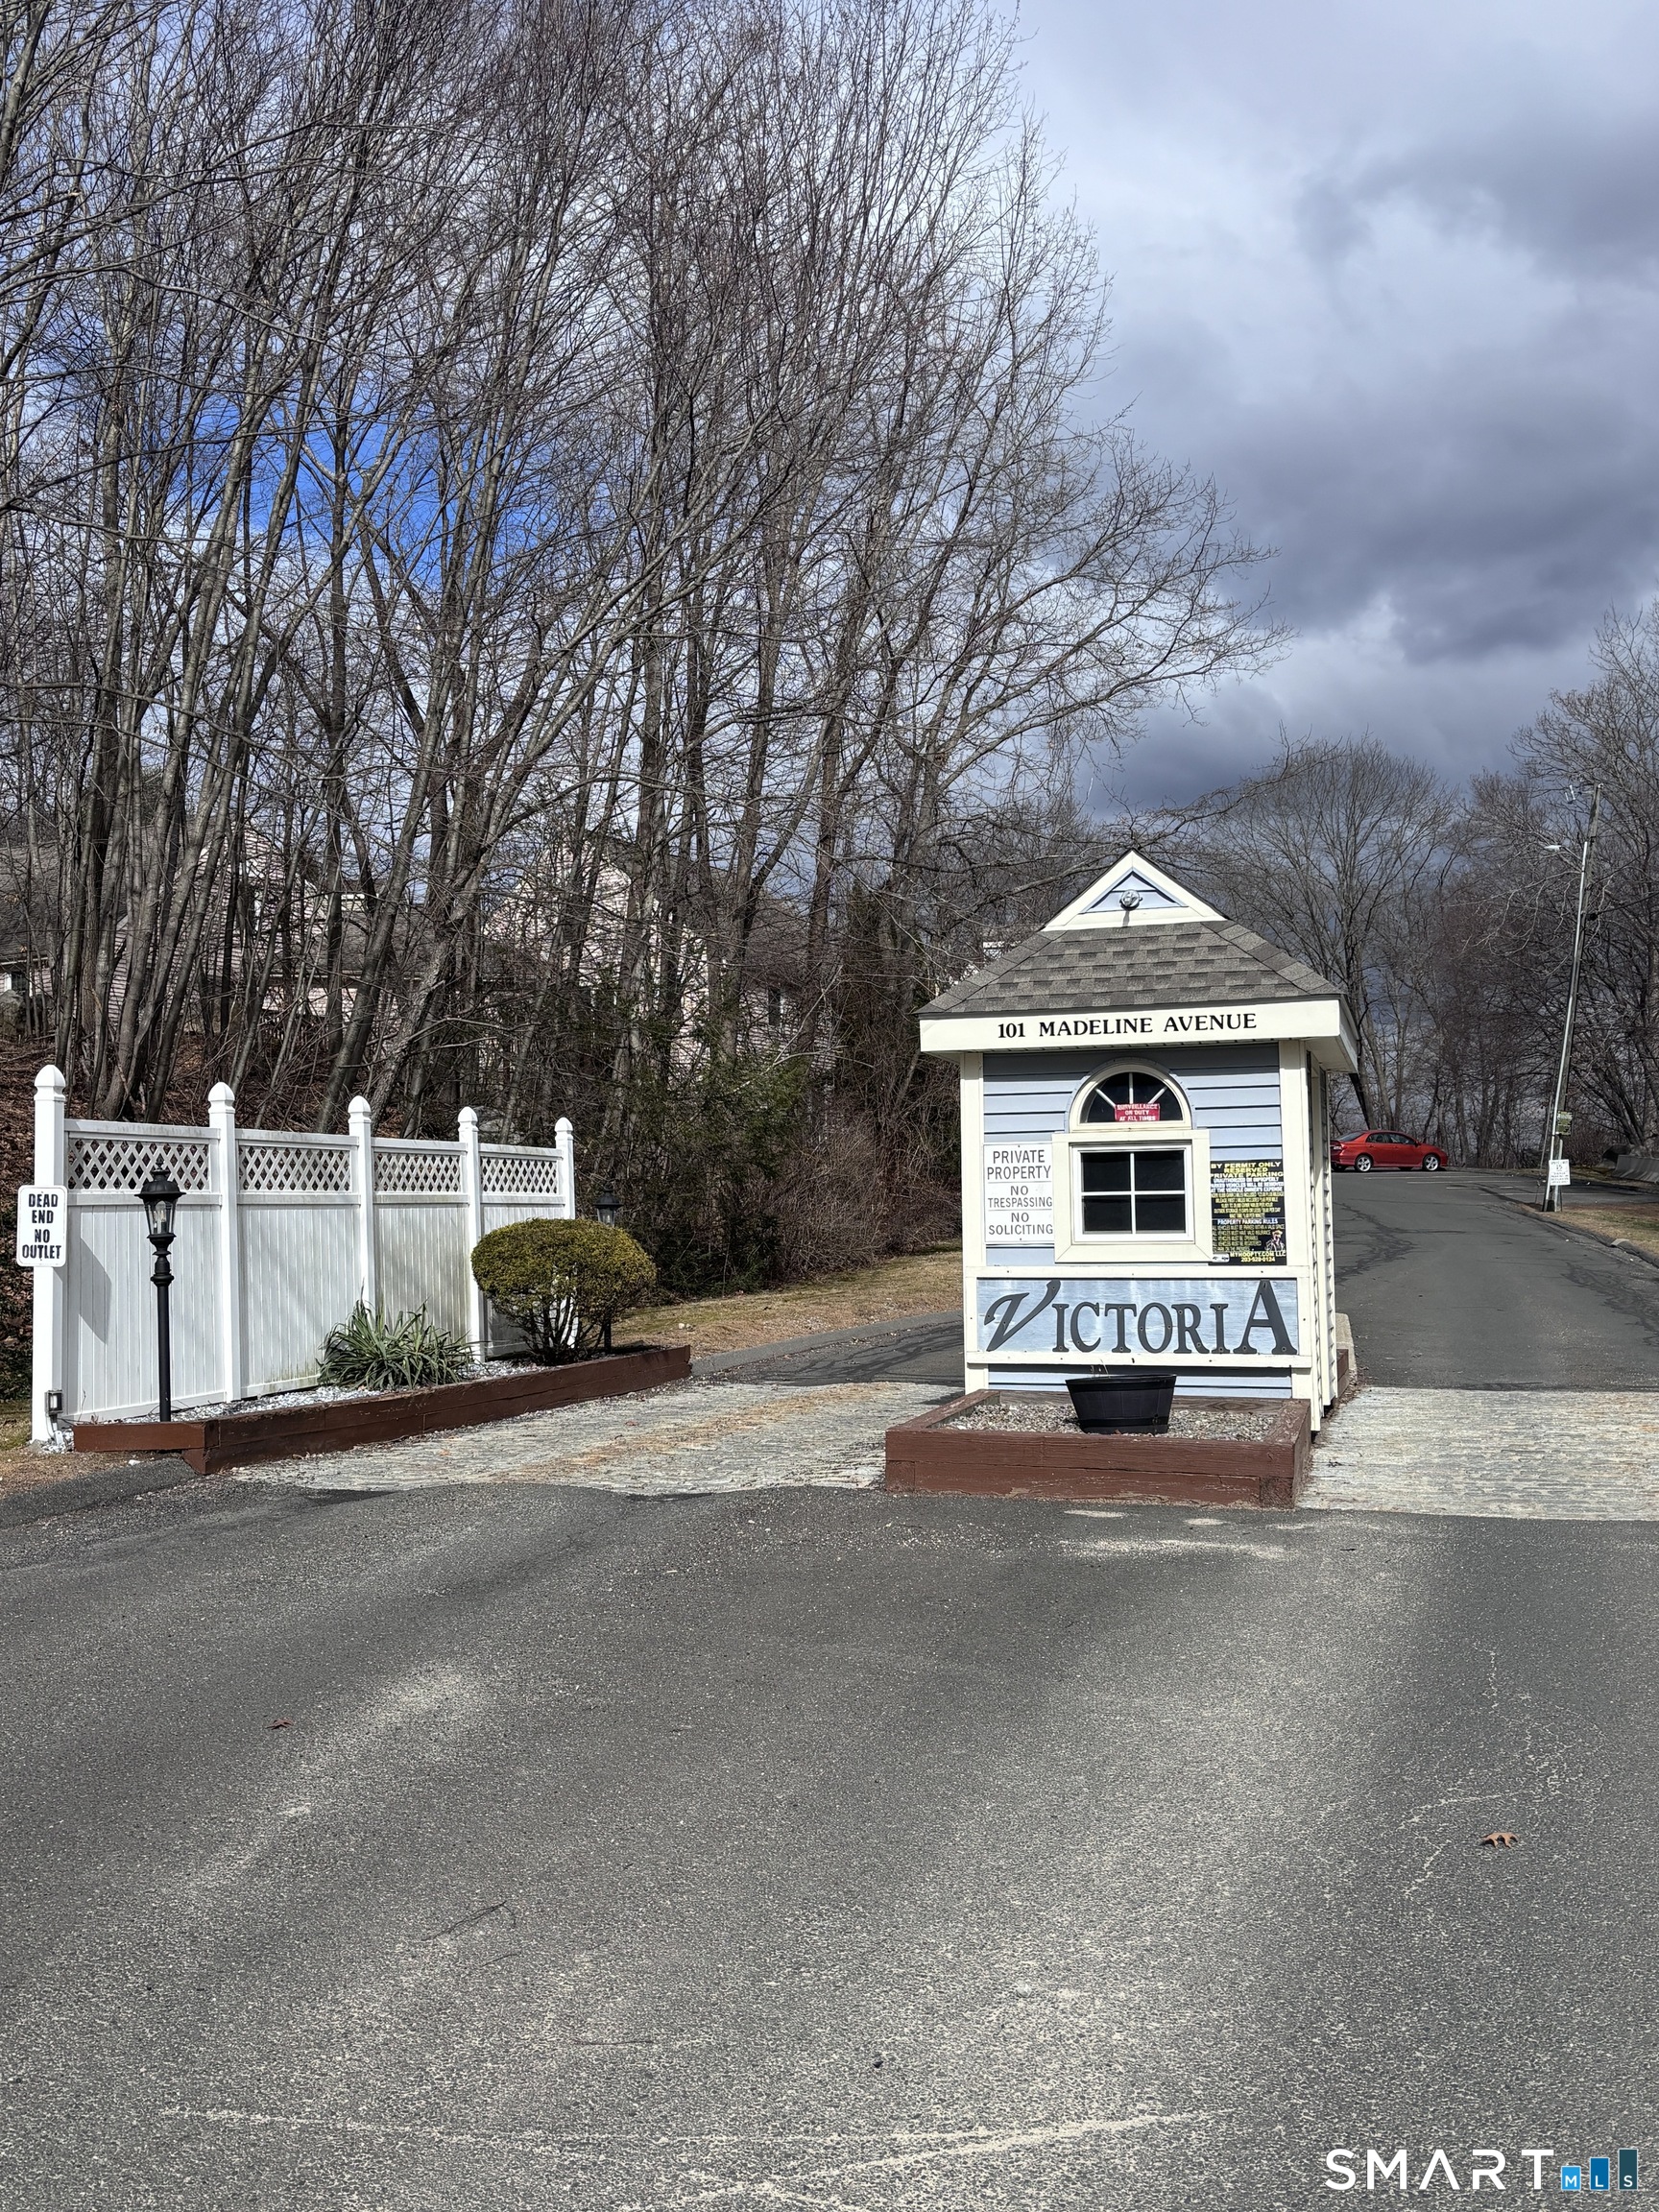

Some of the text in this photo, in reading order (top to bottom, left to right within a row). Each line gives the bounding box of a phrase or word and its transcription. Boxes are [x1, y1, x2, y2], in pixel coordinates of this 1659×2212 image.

[997, 1013, 1258, 1039] 101 MADELINE AVENUE
[993, 1149, 1046, 1165] PRIVATE
[987, 1165, 1051, 1180] PROPERTY
[1010, 1185, 1029, 1195] NO
[29, 1193, 58, 1207] DEAD
[987, 1196, 1053, 1208] TRESPASSING
[32, 1210, 54, 1223] END
[1011, 1212, 1029, 1223] NO
[35, 1229, 51, 1243] NO
[988, 1223, 1053, 1236] SOLICITING
[22, 1244, 61, 1259] OUTLET
[983, 1278, 1297, 1356] VICTORIA
